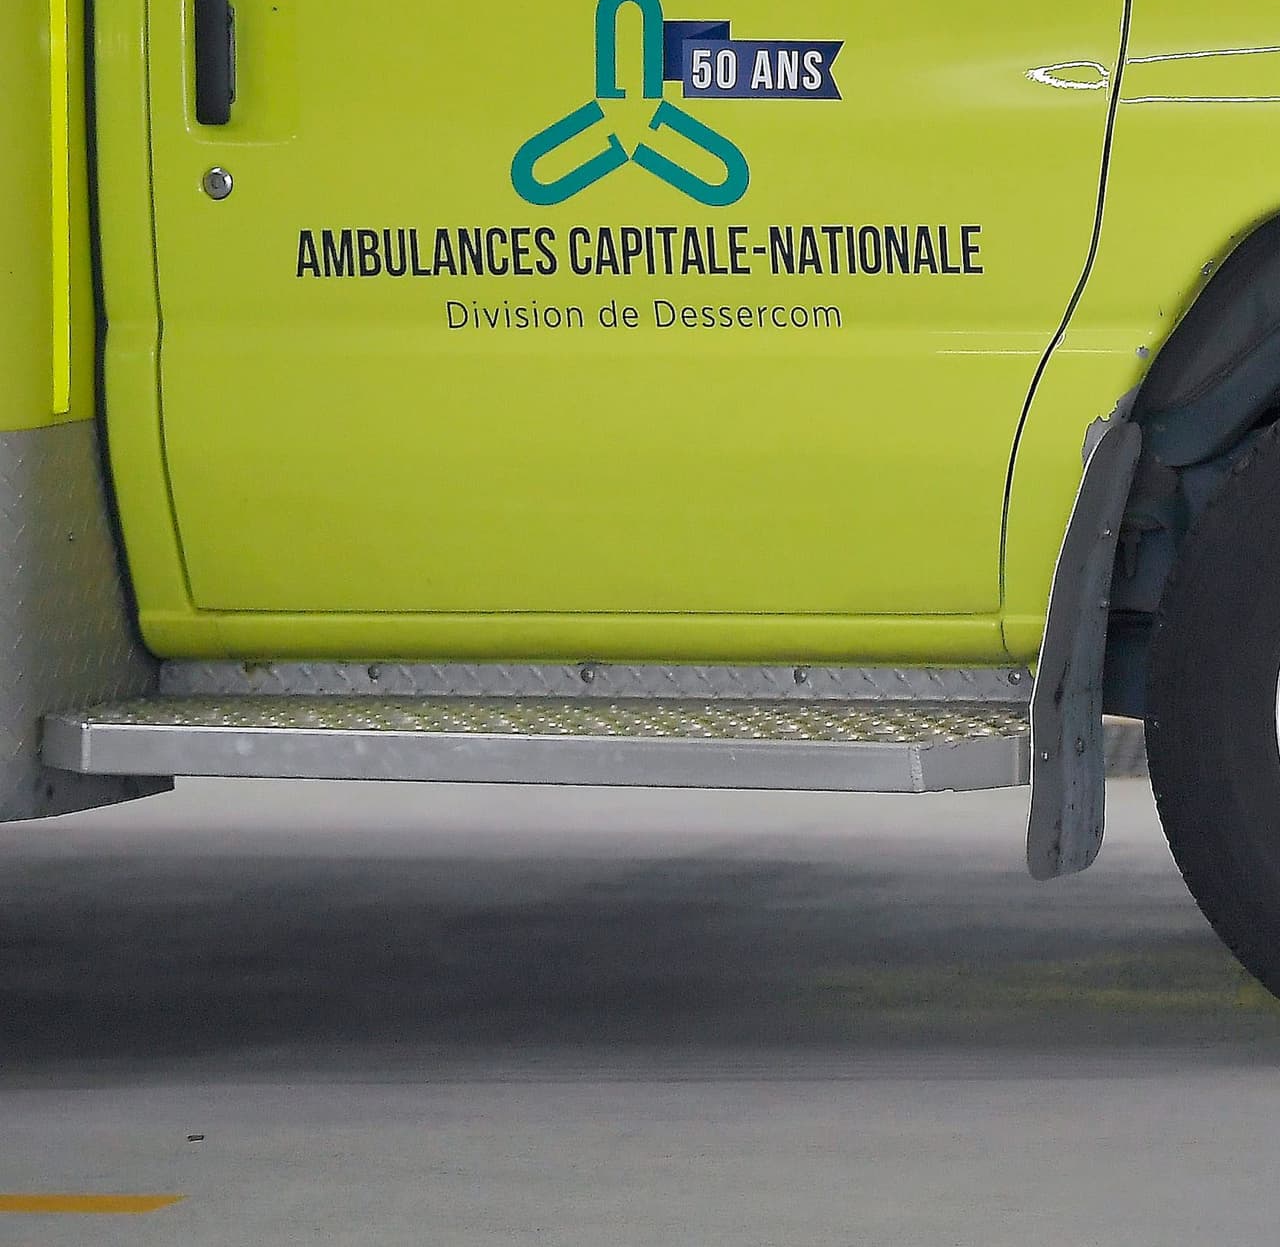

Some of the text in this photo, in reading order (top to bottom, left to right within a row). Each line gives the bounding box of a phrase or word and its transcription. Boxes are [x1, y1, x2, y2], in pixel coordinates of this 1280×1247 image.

[691, 49, 824, 91] 50 ANS
[296, 225, 984, 278] AMBULANCES CAPITALE-NATIONALE
[446, 299, 841, 329] Division de Dessercom
